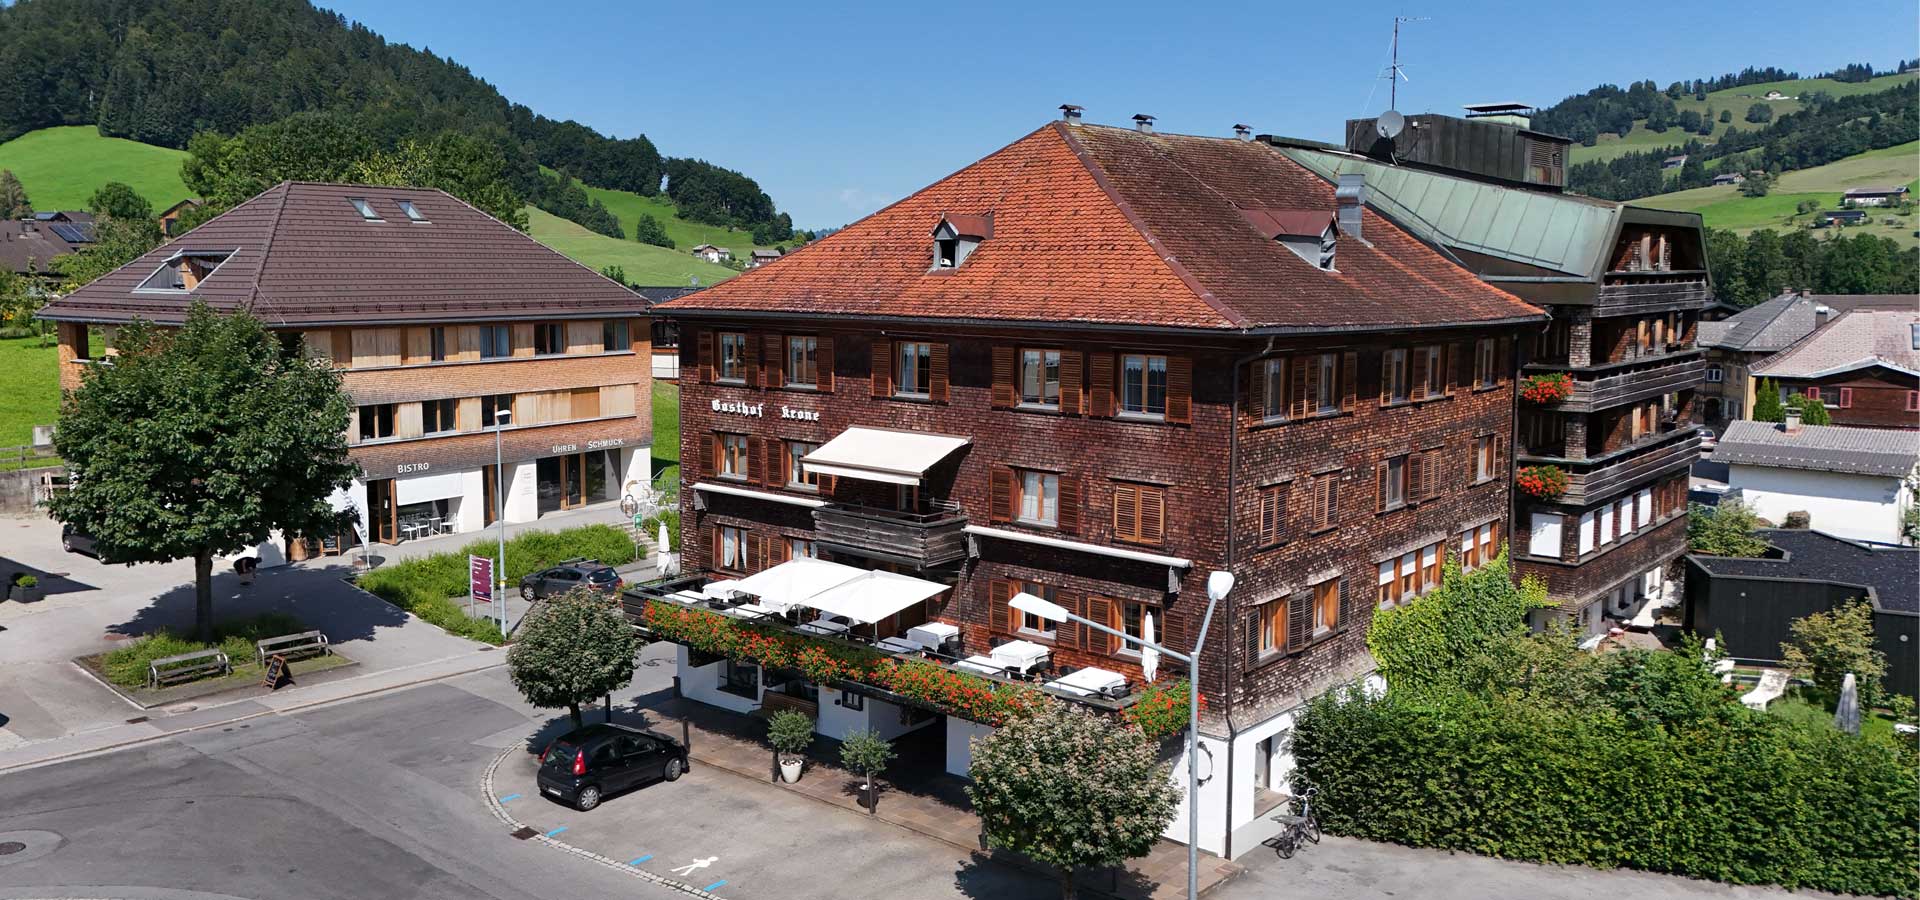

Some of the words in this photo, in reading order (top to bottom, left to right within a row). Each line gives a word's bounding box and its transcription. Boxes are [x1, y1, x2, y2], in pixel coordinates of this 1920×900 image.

[711, 399, 763, 417] Gasthof
[781, 405, 820, 421] Krone
[552, 443, 577, 453] UHREN
[587, 438, 624, 449] SCHMUCK
[397, 462, 430, 474] BISTRO
